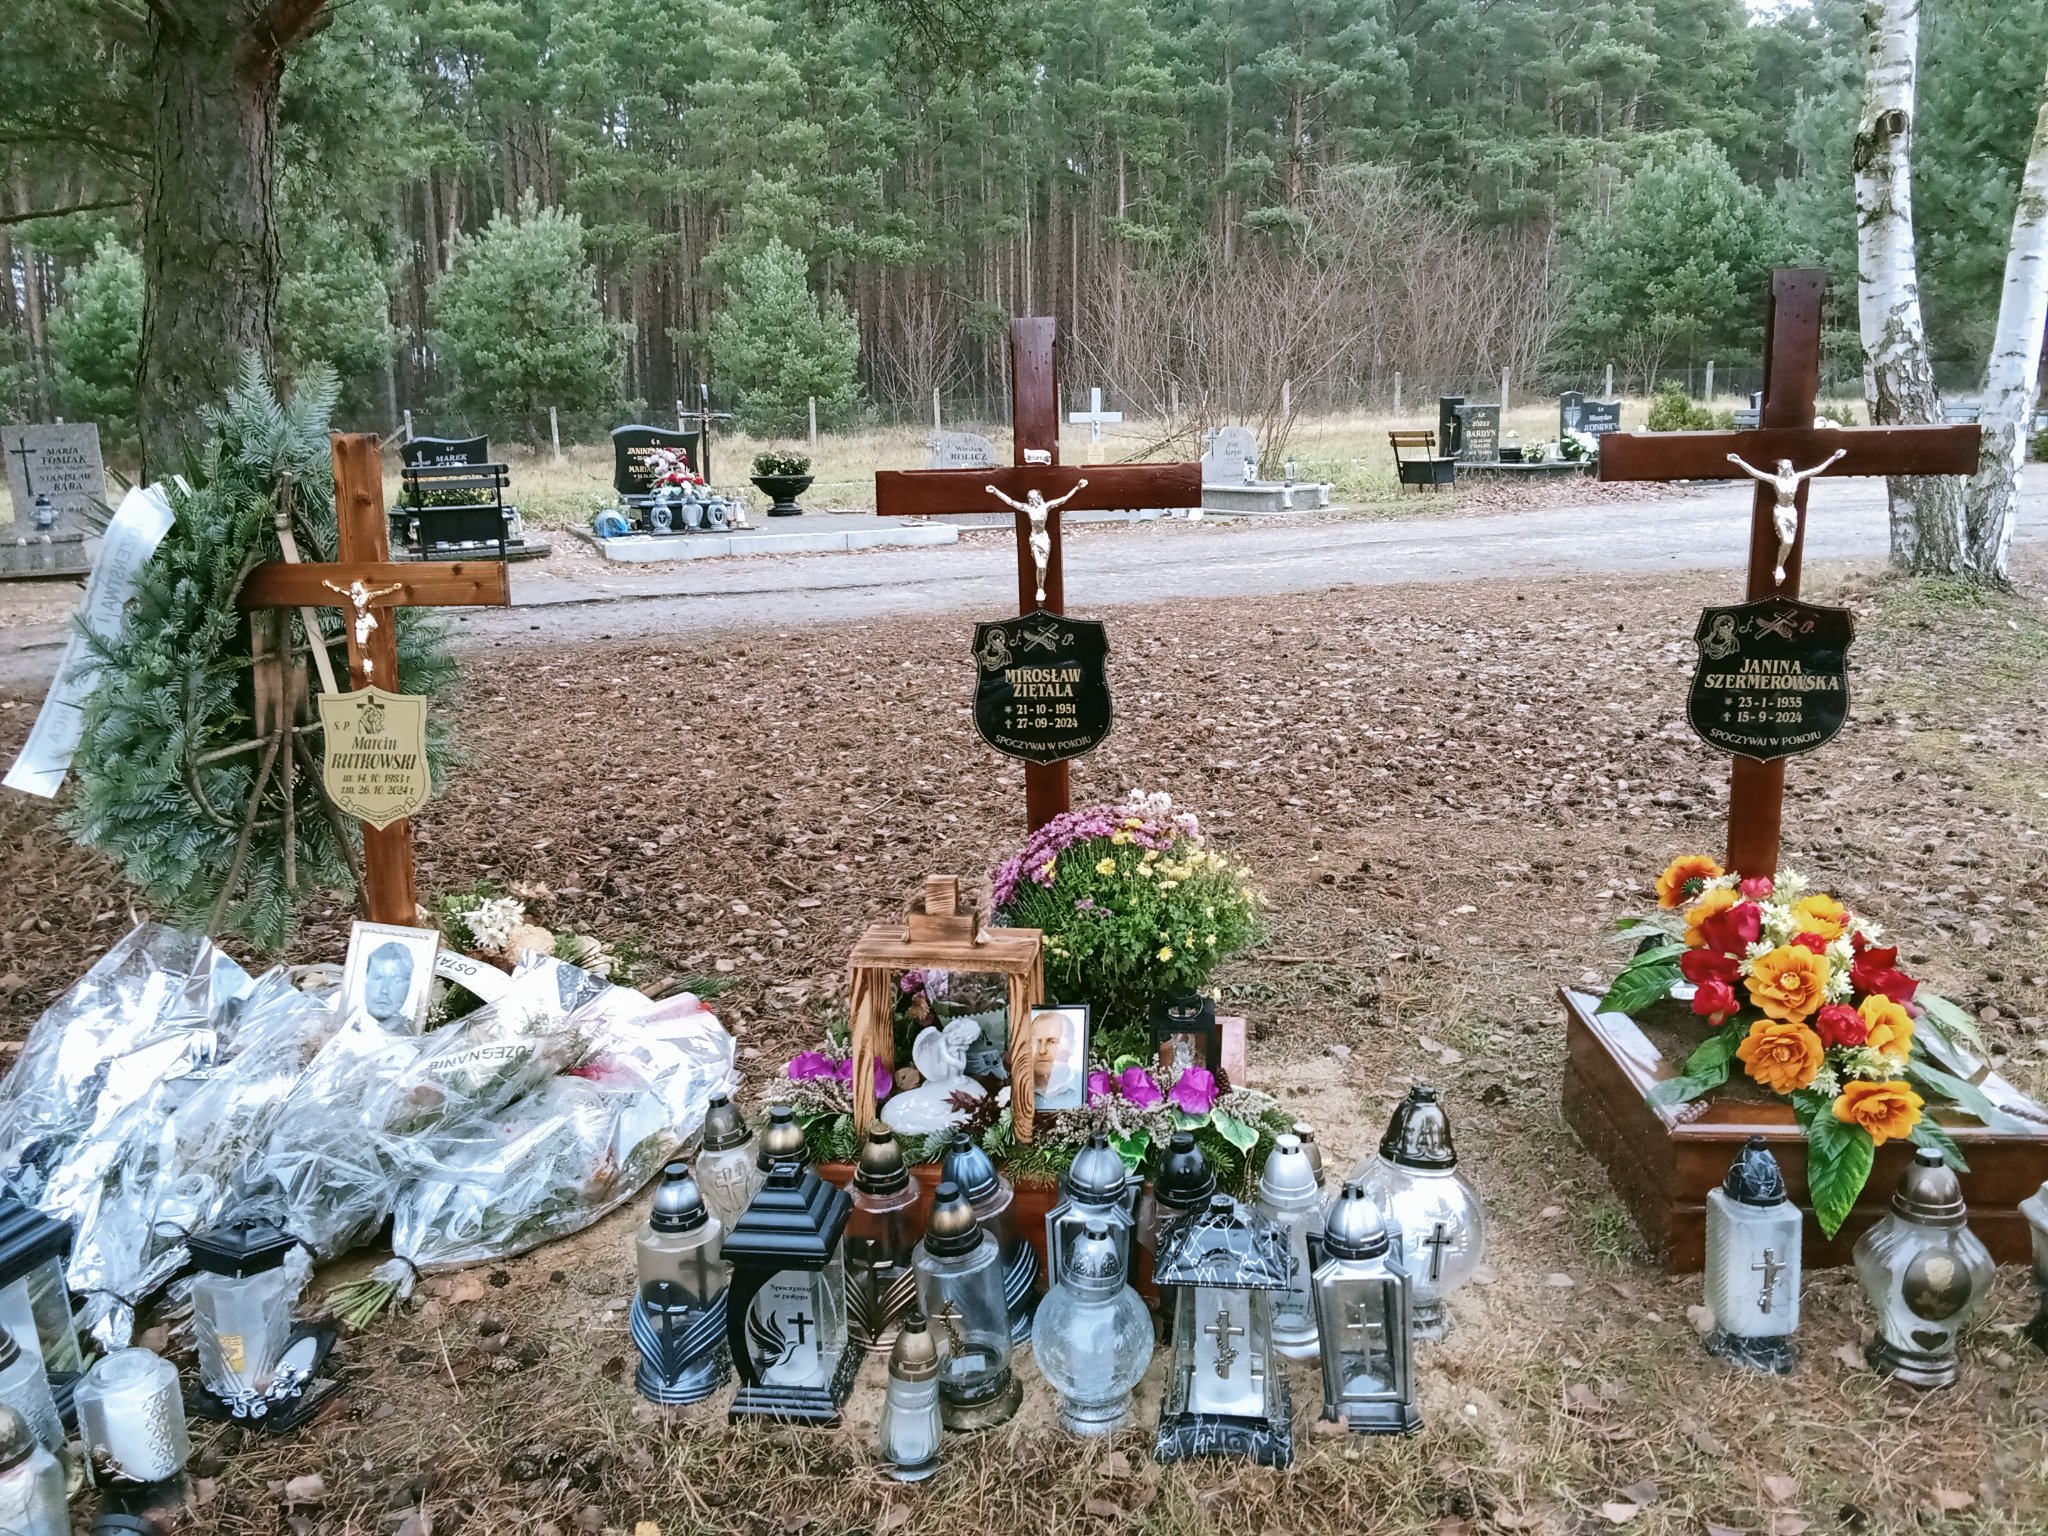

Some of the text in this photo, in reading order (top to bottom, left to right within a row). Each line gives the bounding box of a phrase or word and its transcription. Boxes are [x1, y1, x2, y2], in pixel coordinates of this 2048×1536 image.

[1466, 429, 1496, 438] BARDYN
[46, 447, 79, 456] MARIA
[435, 453, 468, 462] MAREK
[951, 453, 988, 461] ROLICZ
[41, 456, 87, 465] TOMIAK
[628, 465, 656, 473] MARIA
[1739, 658, 1802, 675] JANINA
[1004, 668, 1081, 683] MIROSŁAW
[1704, 673, 1840, 691] SZERMEROWSKA
[1013, 683, 1074, 700] ZIĘTALA
[351, 736, 397, 751] Marcin
[994, 734, 1092, 751] SPOCZYWAJ W POKOJU
[1709, 727, 1822, 746] SPOCZYWAJ W POKOJU
[331, 753, 417, 770] RUTKOWSKI
[386, 786, 409, 796] 2024
[436, 955, 477, 977] OSTA
